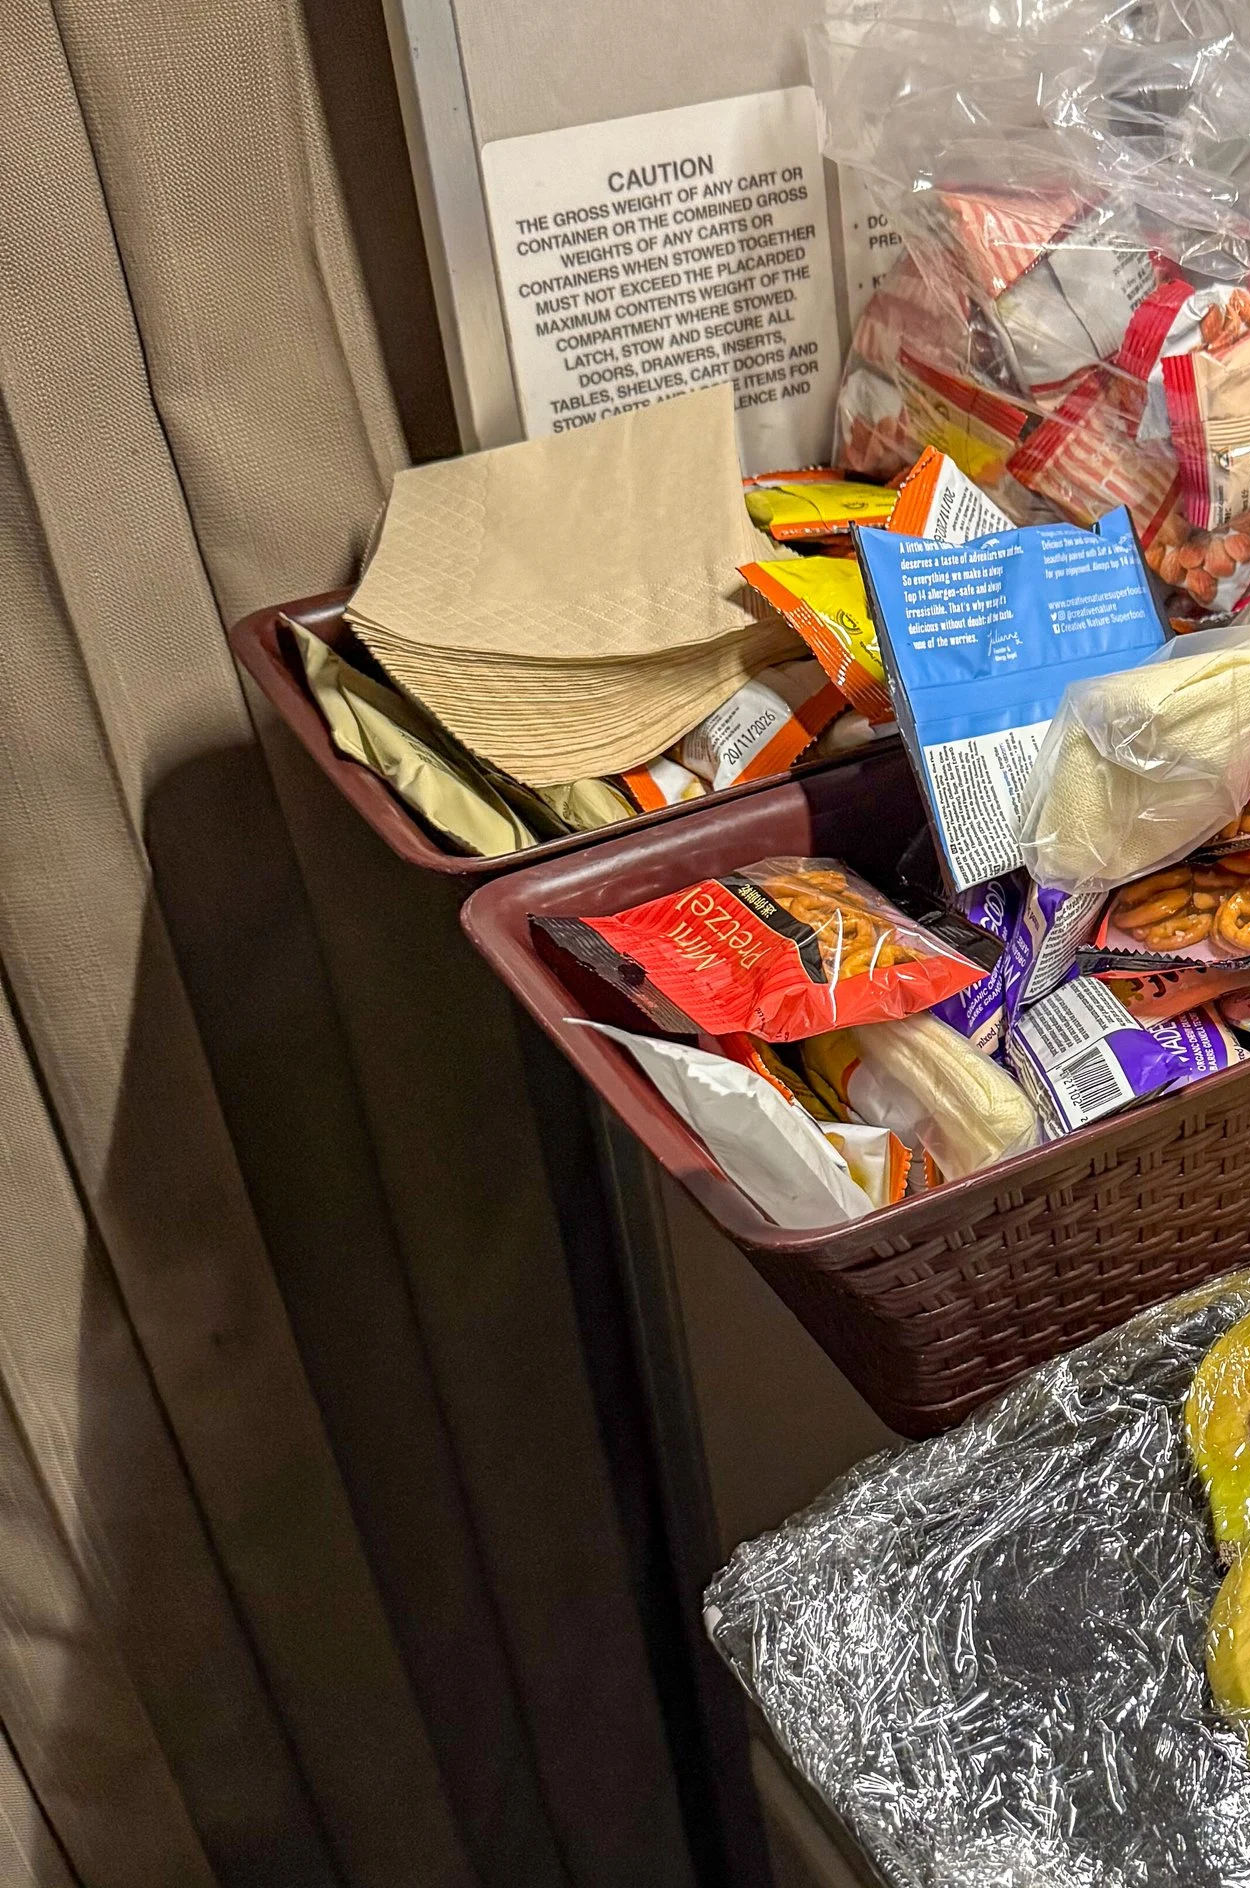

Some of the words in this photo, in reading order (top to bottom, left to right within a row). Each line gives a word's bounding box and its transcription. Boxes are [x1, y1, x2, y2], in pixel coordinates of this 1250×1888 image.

[516, 216, 549, 235] THE
[553, 204, 610, 227] GROSS
[612, 191, 673, 216] WEIGHT
[677, 187, 698, 203] OF
[702, 180, 733, 199] ANY
[737, 171, 777, 191] CART
[781, 166, 804, 183] OR
[608, 154, 714, 193] CAUTION
[517, 226, 608, 256] CONTAINER
[612, 220, 636, 237] OR
[638, 214, 669, 232] THE
[673, 197, 753, 224] COMBINED
[756, 187, 808, 208] GROSS
[560, 242, 633, 269] WEIGHTS
[636, 236, 658, 253] OF
[661, 230, 693, 248] ANY
[697, 219, 748, 240] CARTS
[751, 213, 774, 229] OR
[518, 265, 620, 298] CONTAINERS
[621, 255, 669, 277] WHEN
[672, 242, 736, 267] STOWED
[738, 224, 816, 251] TOGETHER
[535, 294, 580, 316] MUST
[584, 287, 616, 307] NOT
[620, 272, 682, 298] EXCEED
[683, 266, 714, 284] THE
[717, 247, 806, 277] PLACARDED
[535, 308, 612, 337] MAXIMUM
[615, 290, 697, 319] CONTENTS
[699, 276, 757, 300] WEIGHT
[760, 272, 781, 287] OF
[782, 265, 811, 282] THE
[556, 315, 672, 352] COMPARTMENT
[675, 303, 730, 326] WHERE
[733, 289, 798, 314] STOWED.
[564, 349, 619, 371] LATCH,
[622, 337, 665, 358] STOW
[669, 330, 701, 348] AND
[704, 315, 764, 340] SECURE
[767, 309, 795, 326] ALL
[579, 364, 639, 388] DOORS,
[641, 346, 720, 374] DRAWERS,
[722, 331, 787, 355] INSERTS,
[550, 390, 614, 415] TABLES,
[616, 372, 688, 399] SHELVES,
[690, 361, 730, 382] CART
[733, 350, 785, 372] DOORS
[788, 342, 819, 360] AND
[552, 412, 597, 434] STOW
[744, 368, 786, 389] ITEMS
[789, 361, 820, 378] FOR
[780, 381, 811, 400] AND
[899, 542, 905, 554] A
[900, 557, 933, 570] deserves
[934, 558, 939, 567] a
[940, 555, 959, 566] taste
[960, 552, 968, 564] of
[902, 575, 912, 587] So
[913, 571, 950, 586] everything
[951, 572, 962, 581] we
[963, 568, 982, 580] make
[982, 567, 988, 578] is
[904, 590, 917, 604] Top
[927, 585, 975, 601] allergen-safe
[976, 583, 986, 595] and
[905, 604, 948, 619] irresistible.
[948, 600, 971, 614] That's
[972, 599, 985, 612] why
[908, 622, 939, 635] delicious
[940, 618, 966, 630] without
[1060, 619, 1087, 633] Creative
[927, 636, 935, 649] of
[937, 636, 949, 647] the
[949, 632, 978, 646] worries.
[722, 709, 777, 766] 20/11/2026
[660, 921, 727, 971] Mini
